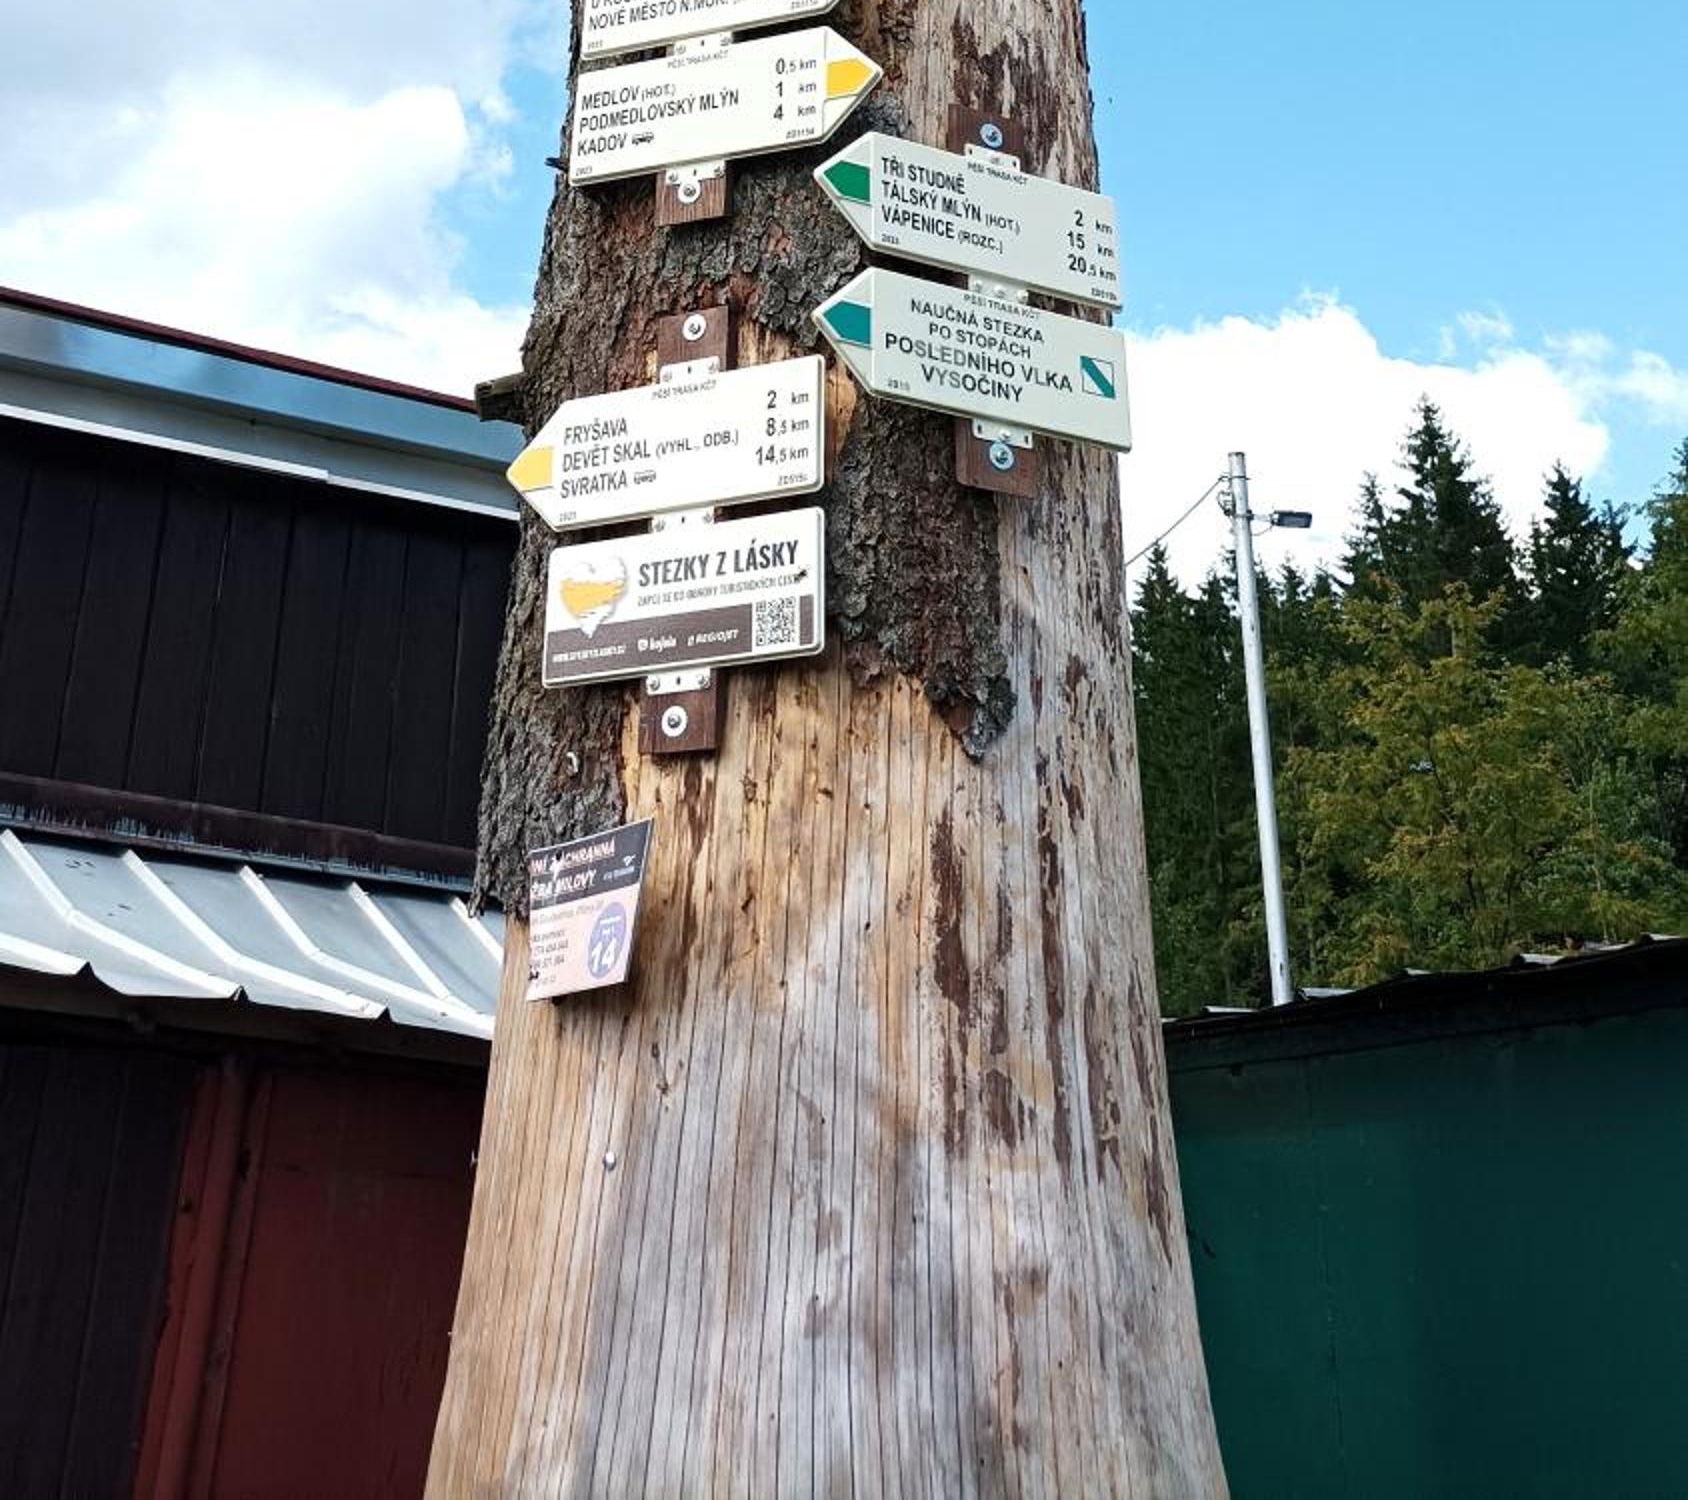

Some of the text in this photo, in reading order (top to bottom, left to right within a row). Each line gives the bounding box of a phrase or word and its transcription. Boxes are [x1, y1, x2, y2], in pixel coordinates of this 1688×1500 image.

[588, 8, 625, 31] NOVÉ
[579, 81, 816, 133] PODMEDLOVSKÝ MLÝN 1 km
[581, 85, 640, 111] MEDLOV
[775, 57, 796, 75] 0,5
[799, 58, 816, 70] km
[577, 103, 816, 157] KADOV 4 km
[881, 155, 904, 178] TŘI
[1074, 209, 1084, 227] 2
[1095, 219, 1113, 234] km
[881, 179, 938, 210] TÁLSKÝ
[941, 197, 981, 223] MLÝN
[1066, 230, 1085, 250] 15
[1097, 243, 1114, 258] km
[881, 203, 955, 239] VÁPENICE
[958, 229, 1003, 255] (ROZC.)
[1067, 253, 1097, 276] 20,5
[1099, 265, 1117, 281] km
[911, 298, 1045, 345] NAUČNÁ STEZKA
[929, 322, 1031, 360] PO STOPÁCH
[885, 333, 1073, 393] POSLEDNÍHO VLKA
[921, 363, 1024, 403] VYSOČINY
[563, 389, 809, 446] FRYŠAVA 2 km
[560, 445, 809, 499] SVRATKA 14,5 km
[562, 443, 611, 473] DEVĚT
[613, 439, 652, 464] SKAL
[703, 429, 740, 448] ODB.)
[765, 417, 787, 437] 8,5
[791, 419, 809, 433] km
[638, 537, 799, 588] STEZKY Z LÁSKY
[591, 940, 616, 974] 14
